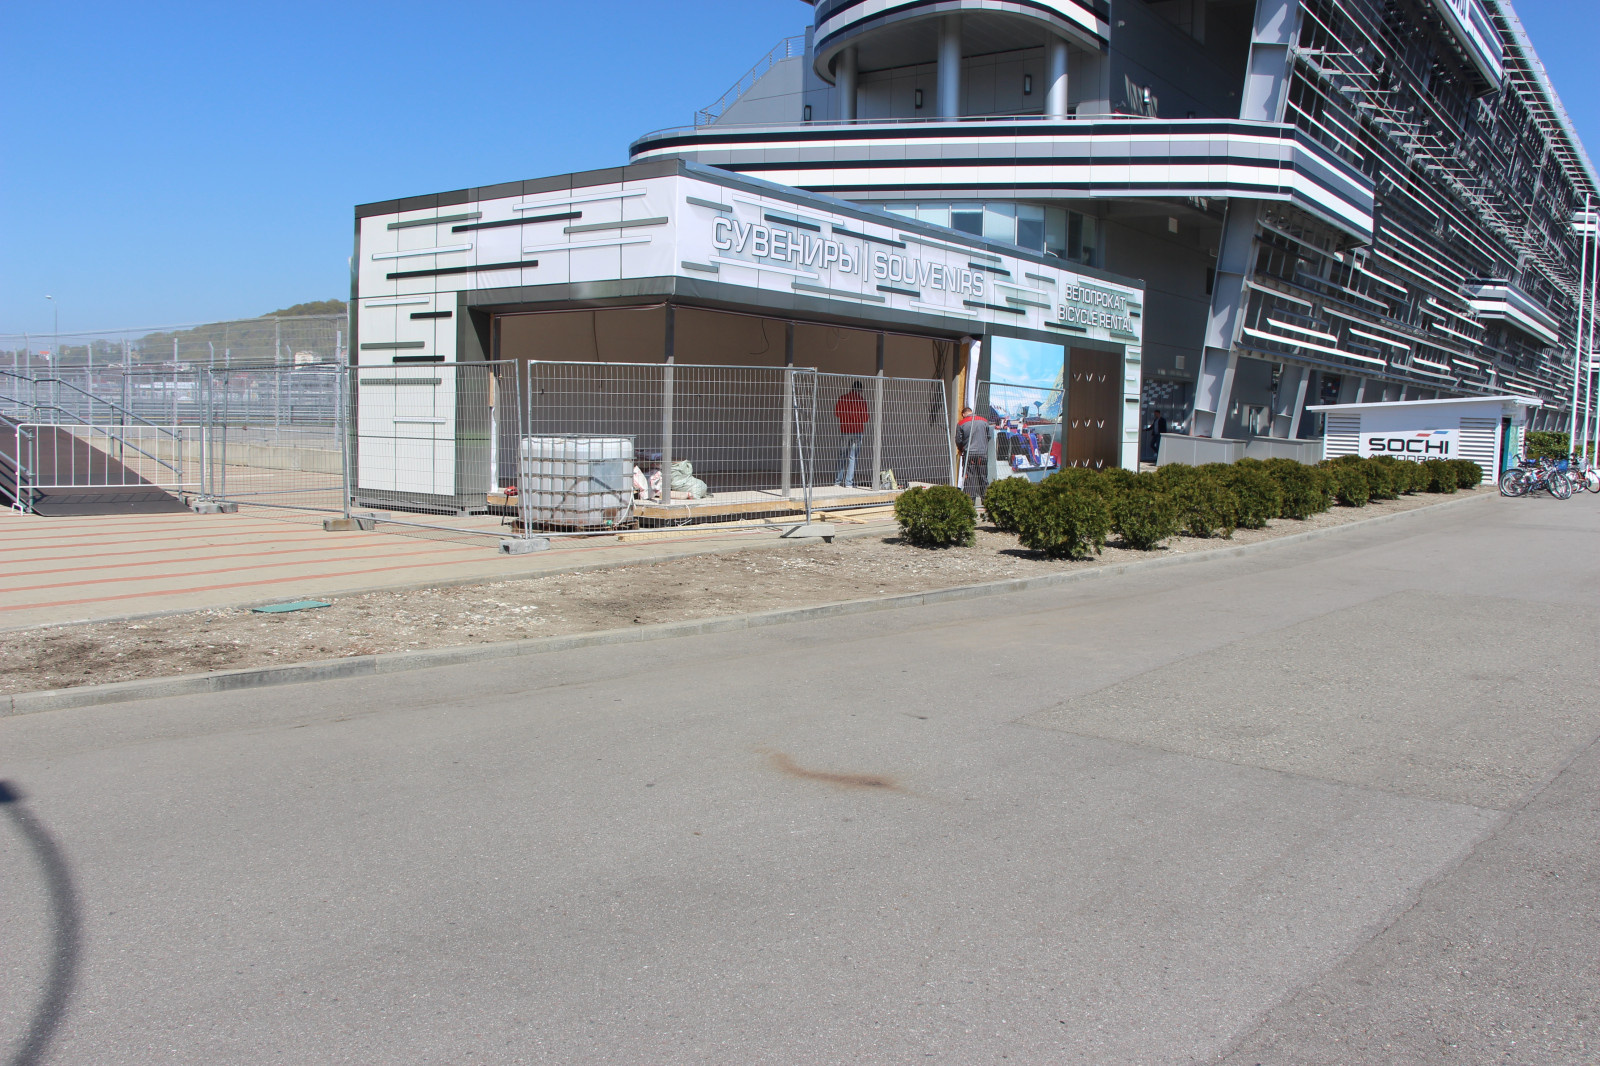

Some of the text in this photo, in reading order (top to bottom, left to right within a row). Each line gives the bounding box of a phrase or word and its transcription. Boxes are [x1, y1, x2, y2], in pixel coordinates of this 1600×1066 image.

[711, 215, 860, 275] СУВЕНИРЫ
[873, 250, 984, 297] SOUVENIRS
[1065, 282, 1126, 312] ВЕЛОПРОКАТ
[1058, 303, 1134, 334] BICYCLE RENTAL
[1368, 437, 1449, 454] SOCHI
